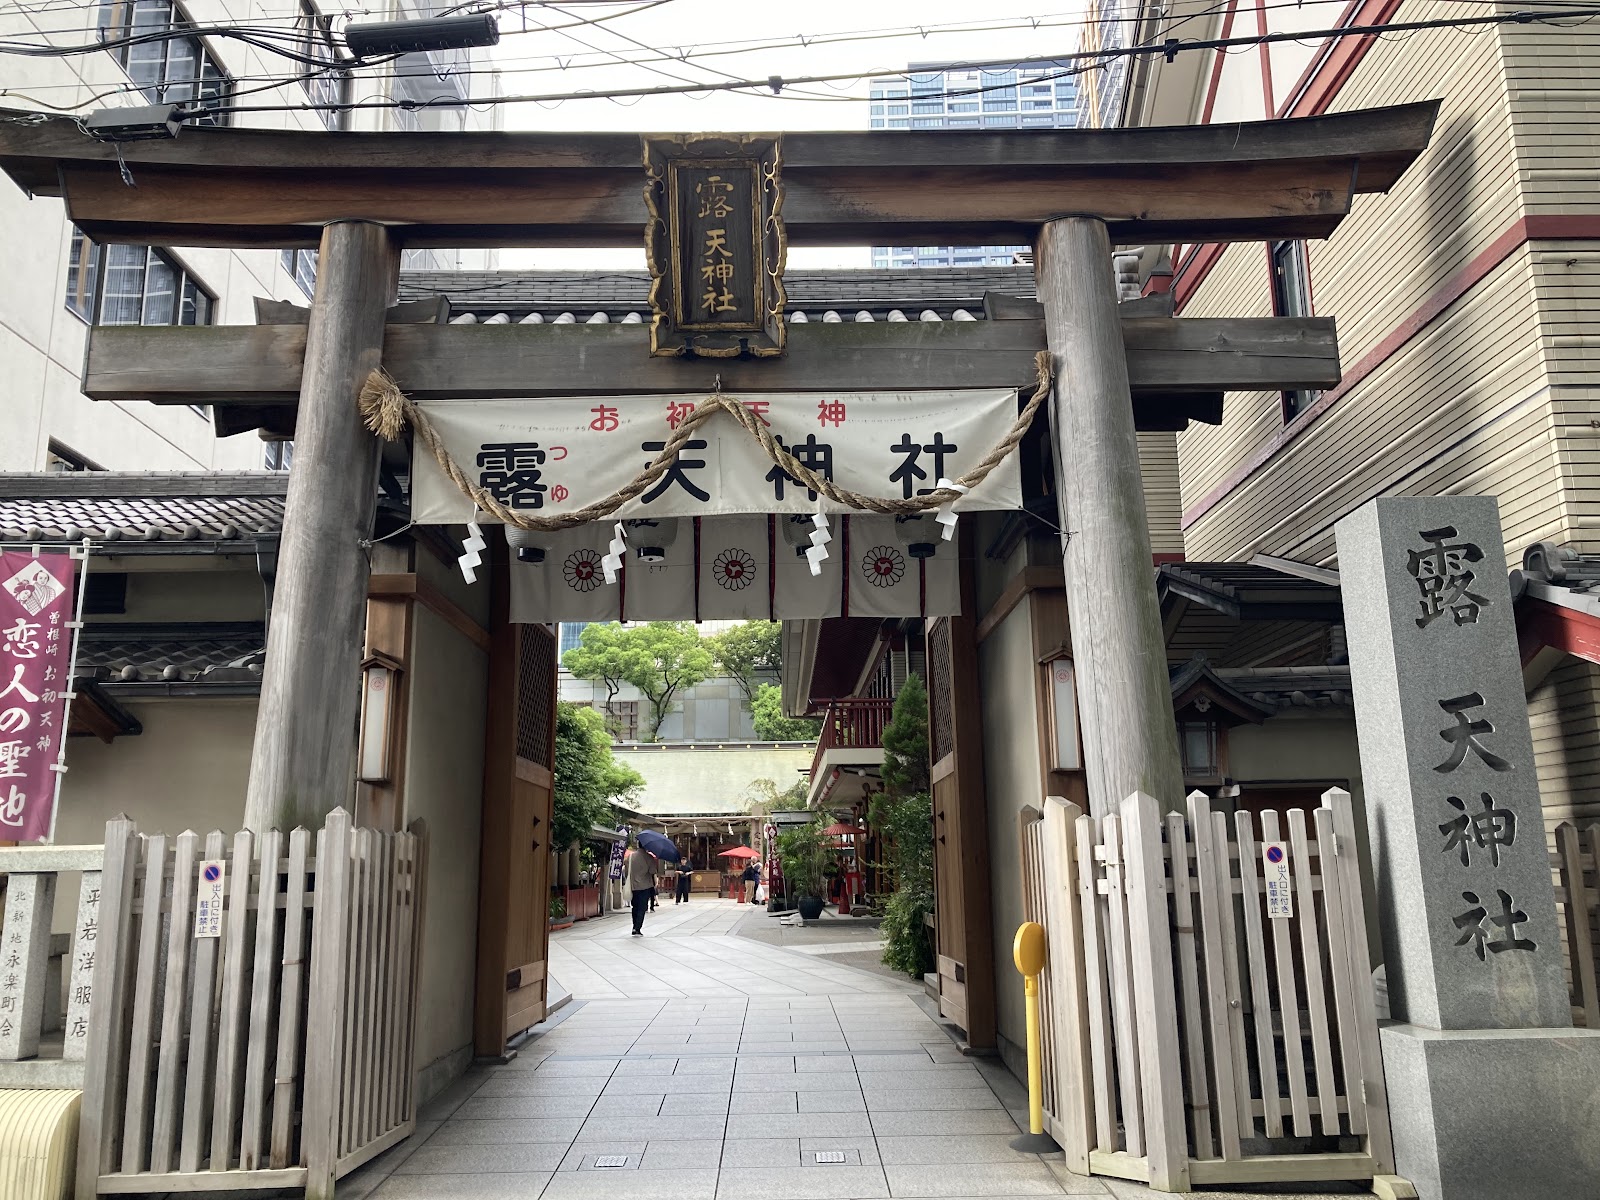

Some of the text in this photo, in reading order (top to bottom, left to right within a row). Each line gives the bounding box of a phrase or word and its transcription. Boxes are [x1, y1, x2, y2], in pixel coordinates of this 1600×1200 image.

[696, 175, 737, 313] 露天神社
[590, 399, 846, 432] お初天神
[476, 432, 958, 511] 露天神社
[549, 446, 569, 503] つゆ
[0, 618, 41, 826] 恋人の聖地
[1406, 525, 1538, 962] 露天神社
[198, 900, 209, 933] 駐車禁止
[210, 884, 221, 933] 出入口に付き
[1268, 881, 1279, 913] 駐車禁止
[1277, 864, 1289, 913] 出入口に付き
[0, 891, 26, 1037] 北新地永楽町会
[71, 889, 100, 1038] 平岩洋服店
